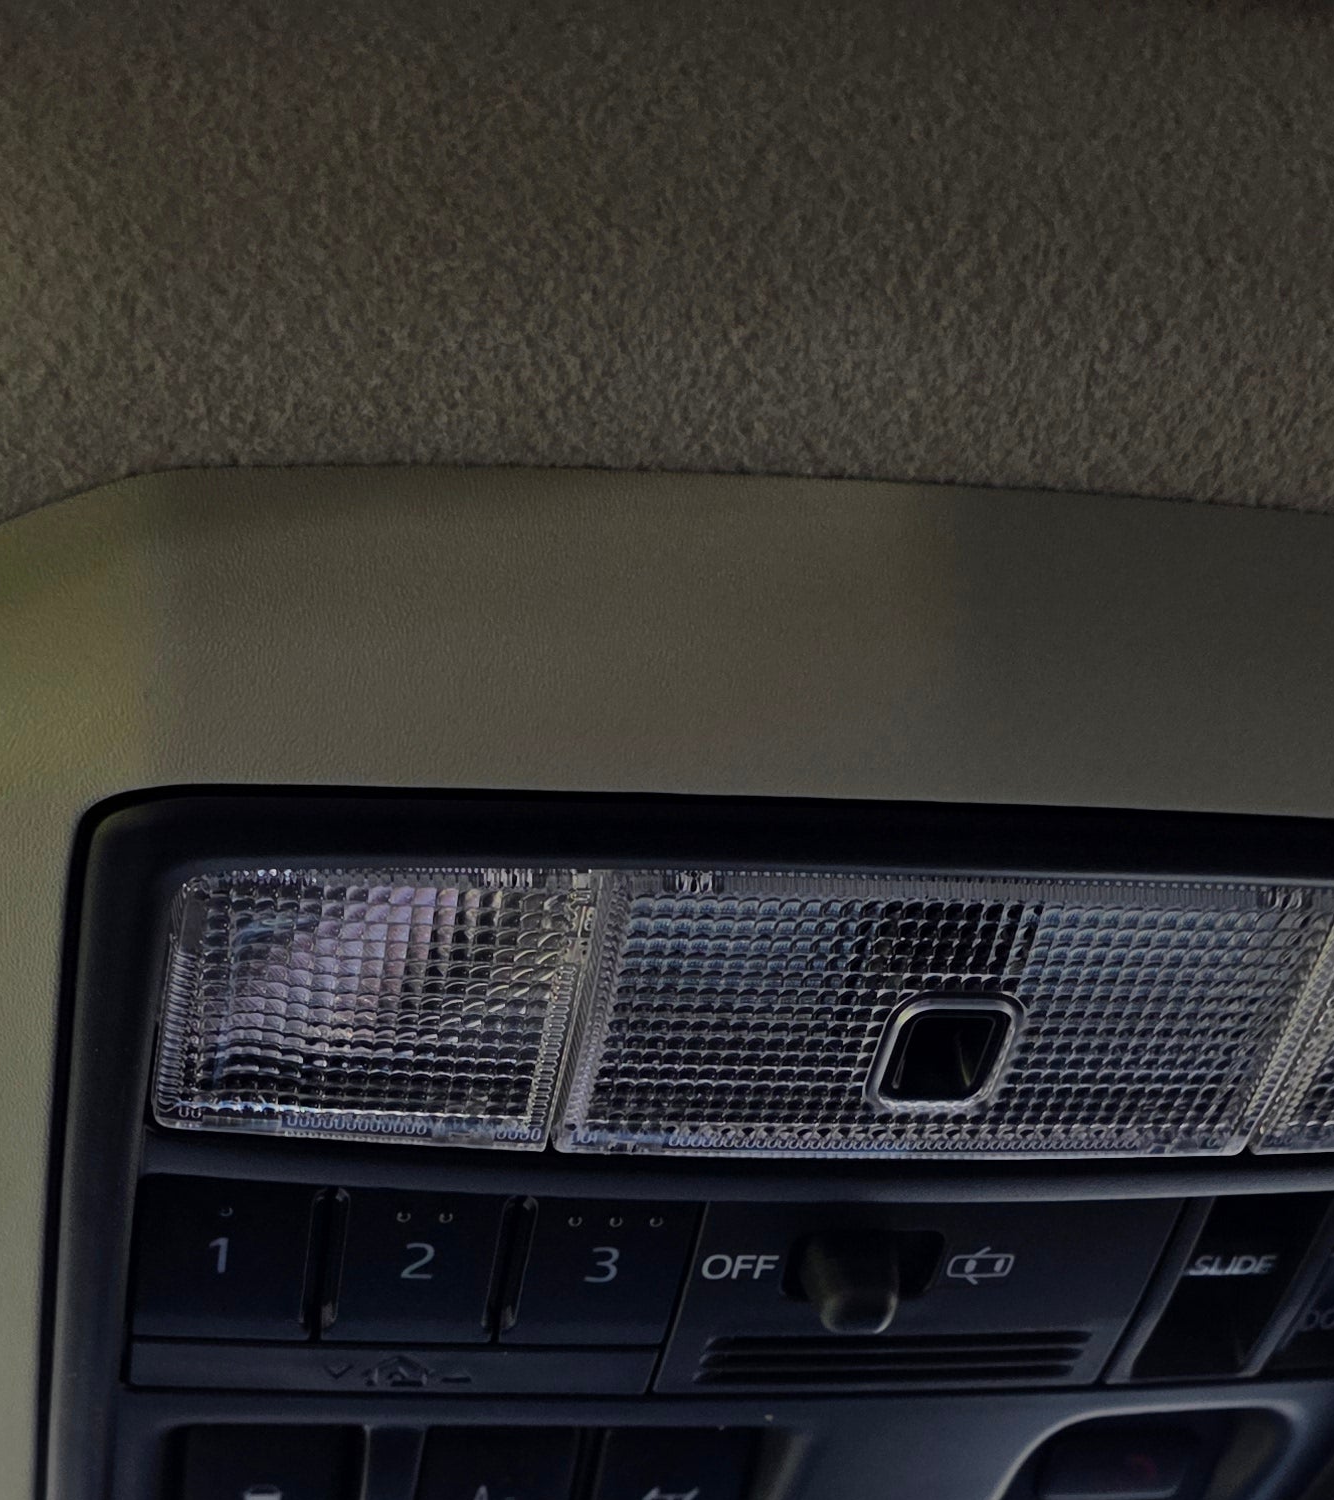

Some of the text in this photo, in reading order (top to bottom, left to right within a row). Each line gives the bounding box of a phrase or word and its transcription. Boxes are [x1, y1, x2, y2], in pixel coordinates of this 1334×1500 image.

[208, 1236, 229, 1275] 1
[399, 1241, 436, 1281] 2
[583, 1246, 620, 1284] 3
[700, 1253, 779, 1281] OFF
[1189, 1254, 1277, 1277] SLIDE
